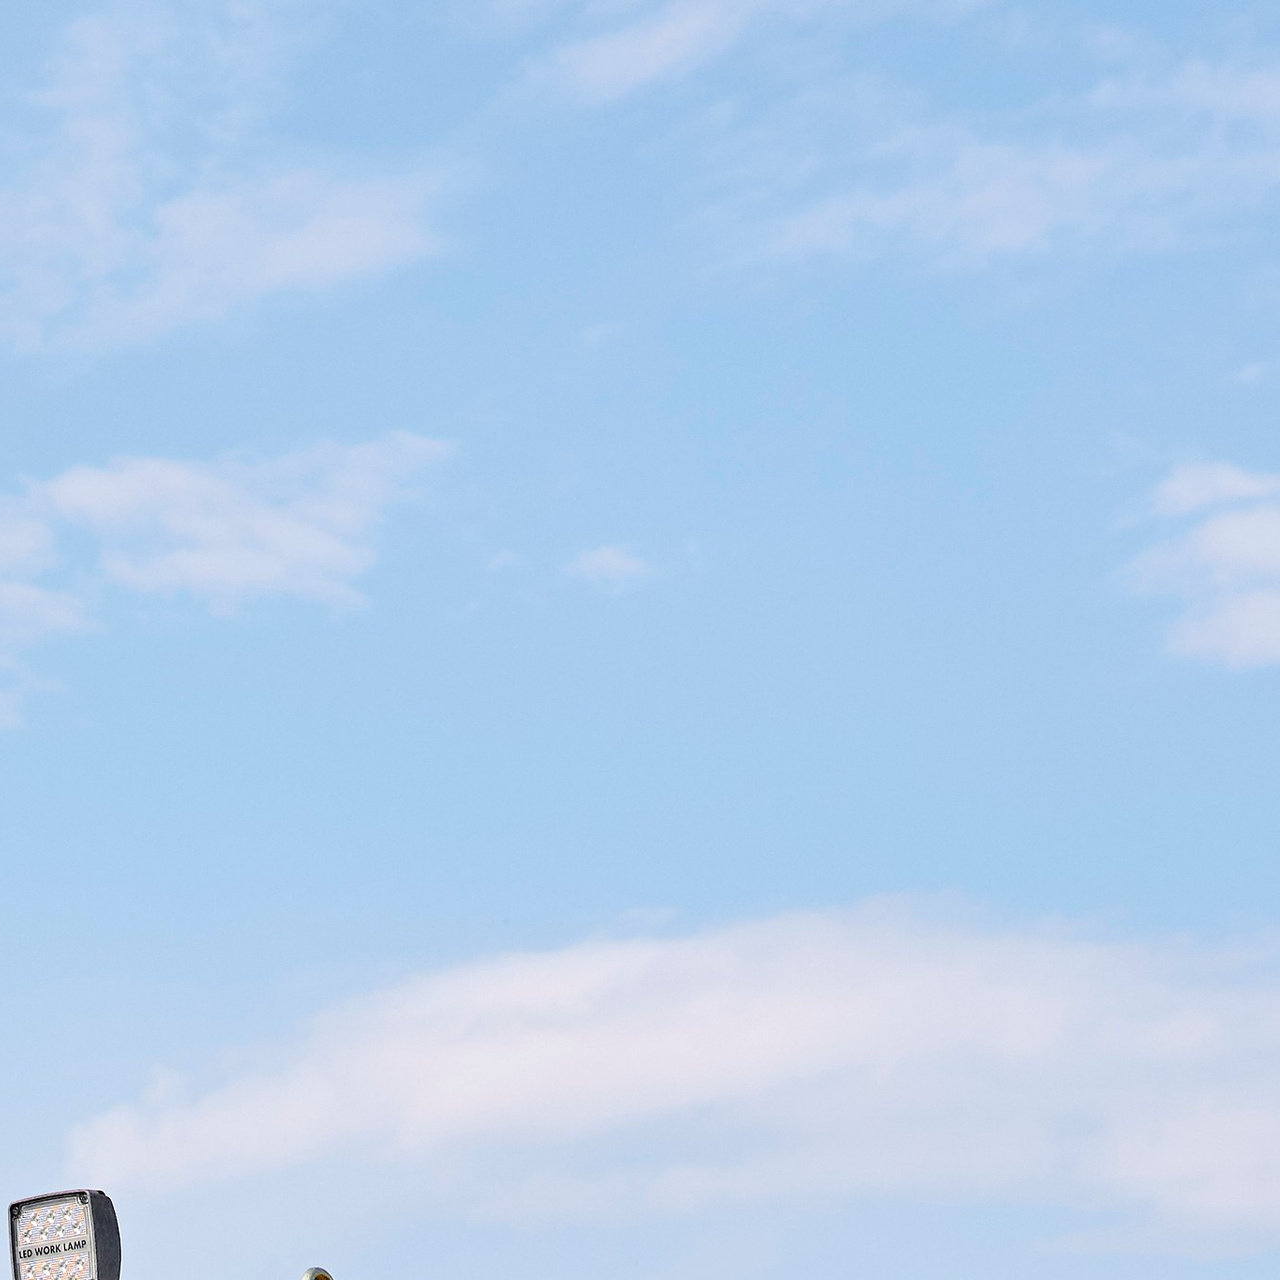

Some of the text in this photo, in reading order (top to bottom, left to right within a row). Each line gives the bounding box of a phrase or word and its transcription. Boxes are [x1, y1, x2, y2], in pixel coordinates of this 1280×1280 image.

[19, 1239, 86, 1260] LED WORK LAMP
